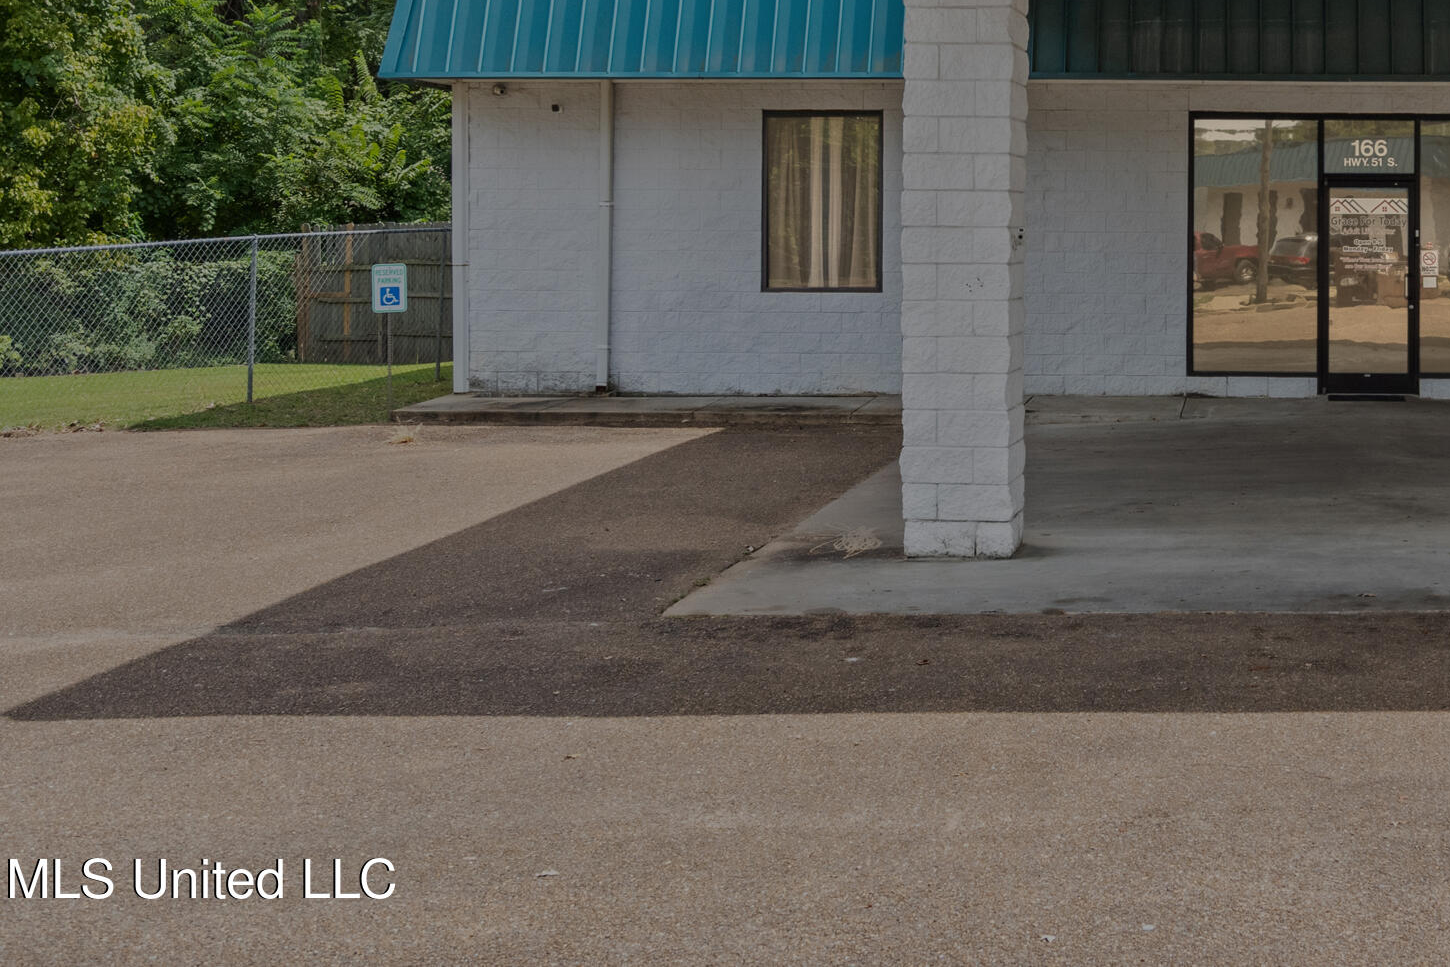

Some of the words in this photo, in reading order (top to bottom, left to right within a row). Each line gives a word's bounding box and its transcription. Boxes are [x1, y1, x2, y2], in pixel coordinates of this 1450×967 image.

[1351, 139, 1388, 157] 166
[1343, 157, 1369, 167] HWY.
[1371, 157, 1383, 167] 51
[1387, 157, 1398, 167] S.
[1379, 216, 1407, 228] Today
